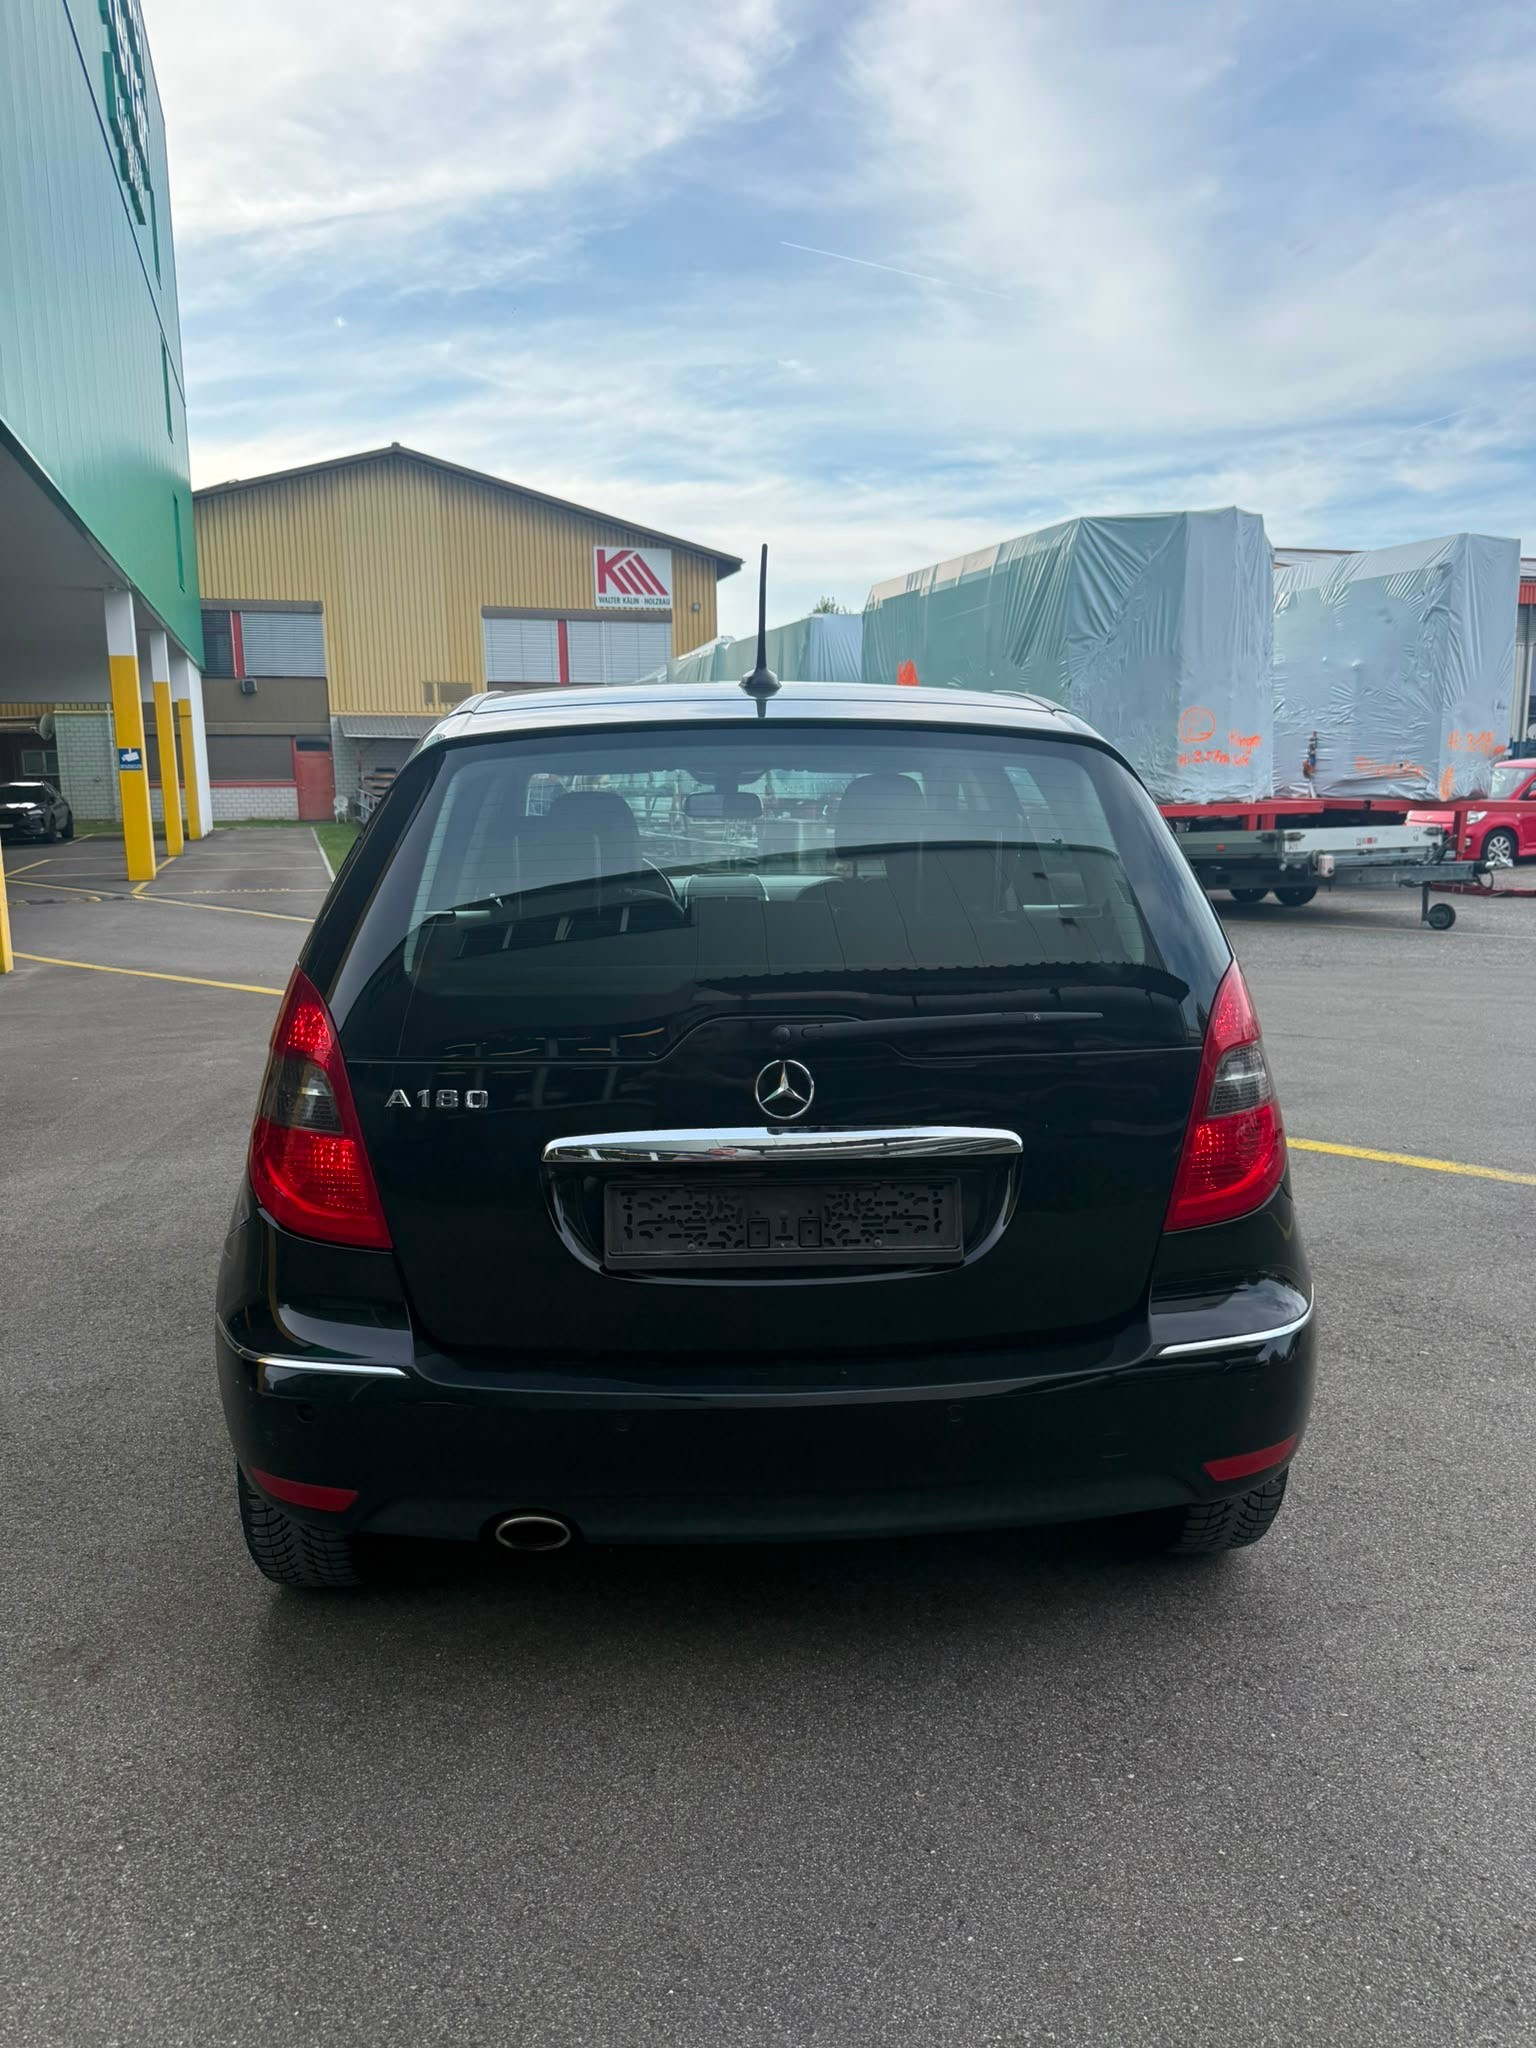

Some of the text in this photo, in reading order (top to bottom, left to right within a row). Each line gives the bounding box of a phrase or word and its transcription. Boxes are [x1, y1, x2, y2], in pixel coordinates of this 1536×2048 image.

[598, 596, 671, 605] WALTER KÄLIN HOLZBAU
